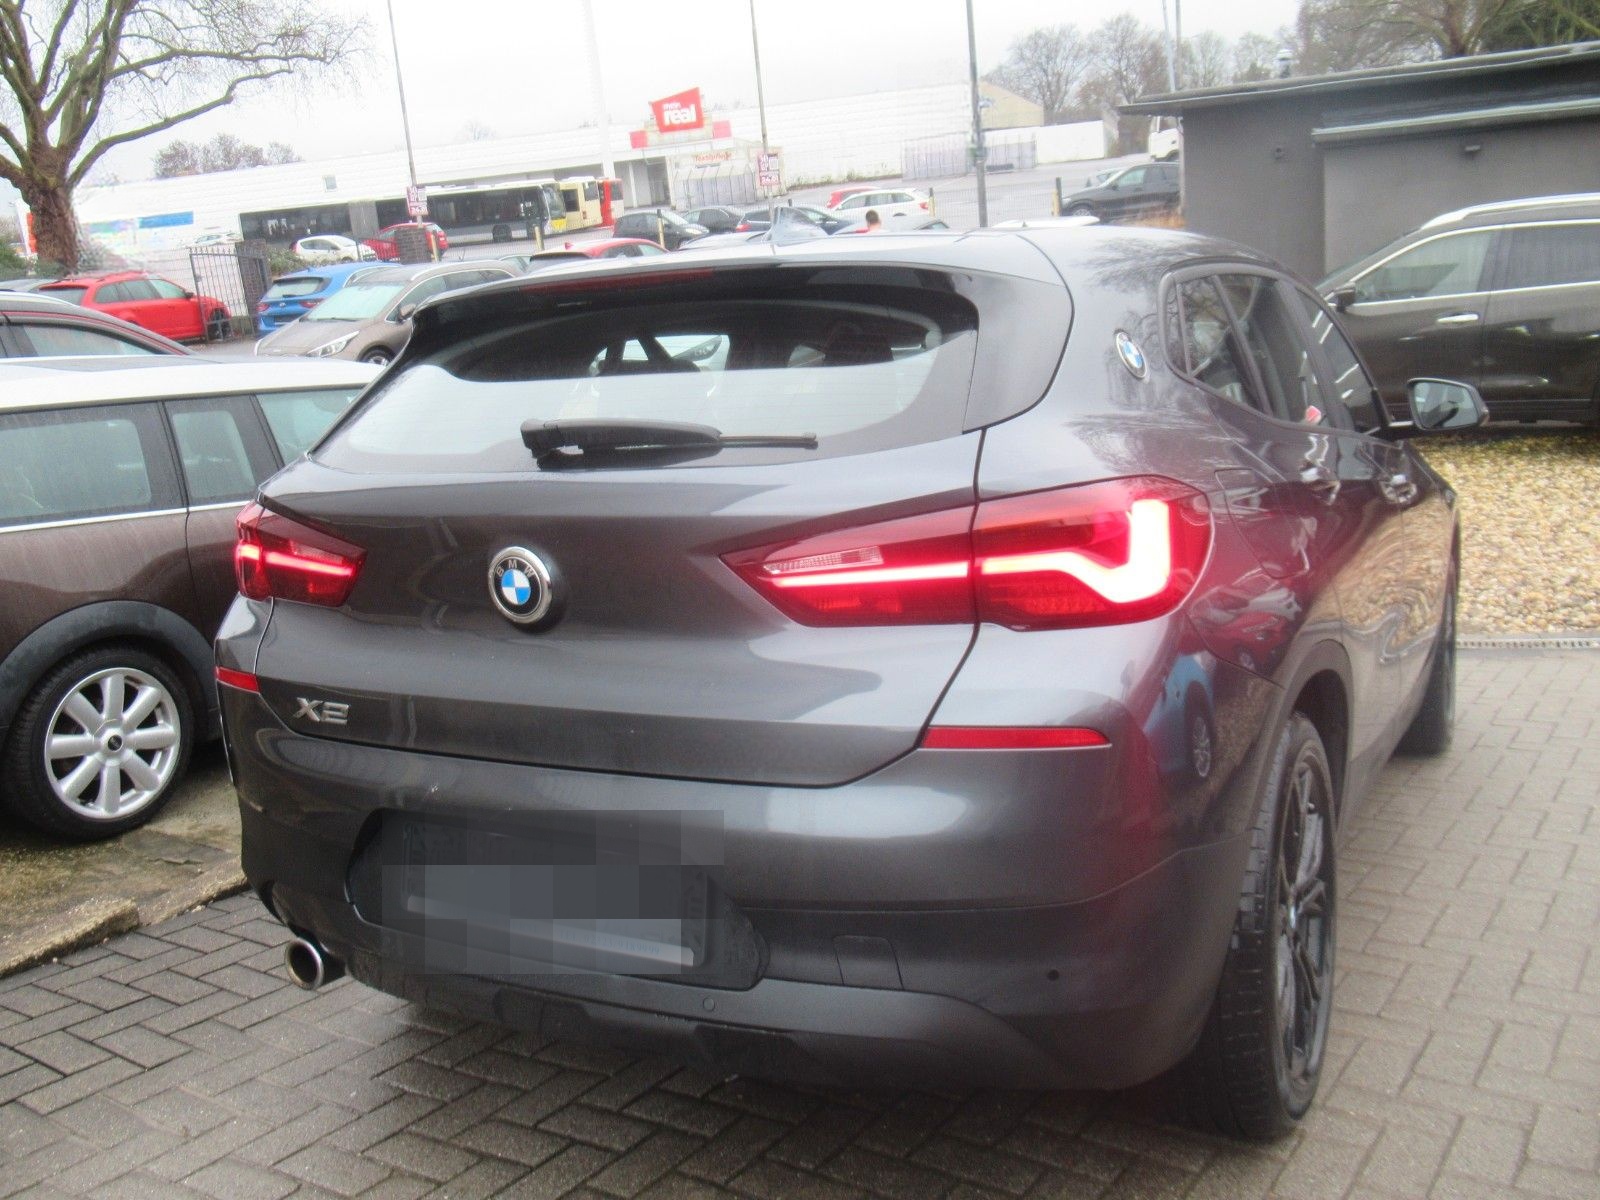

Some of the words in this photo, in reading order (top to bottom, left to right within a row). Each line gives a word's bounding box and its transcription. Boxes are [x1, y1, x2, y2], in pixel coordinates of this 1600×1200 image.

[663, 103, 697, 126] real
[496, 559, 535, 578] BMW
[292, 697, 350, 725] X2
